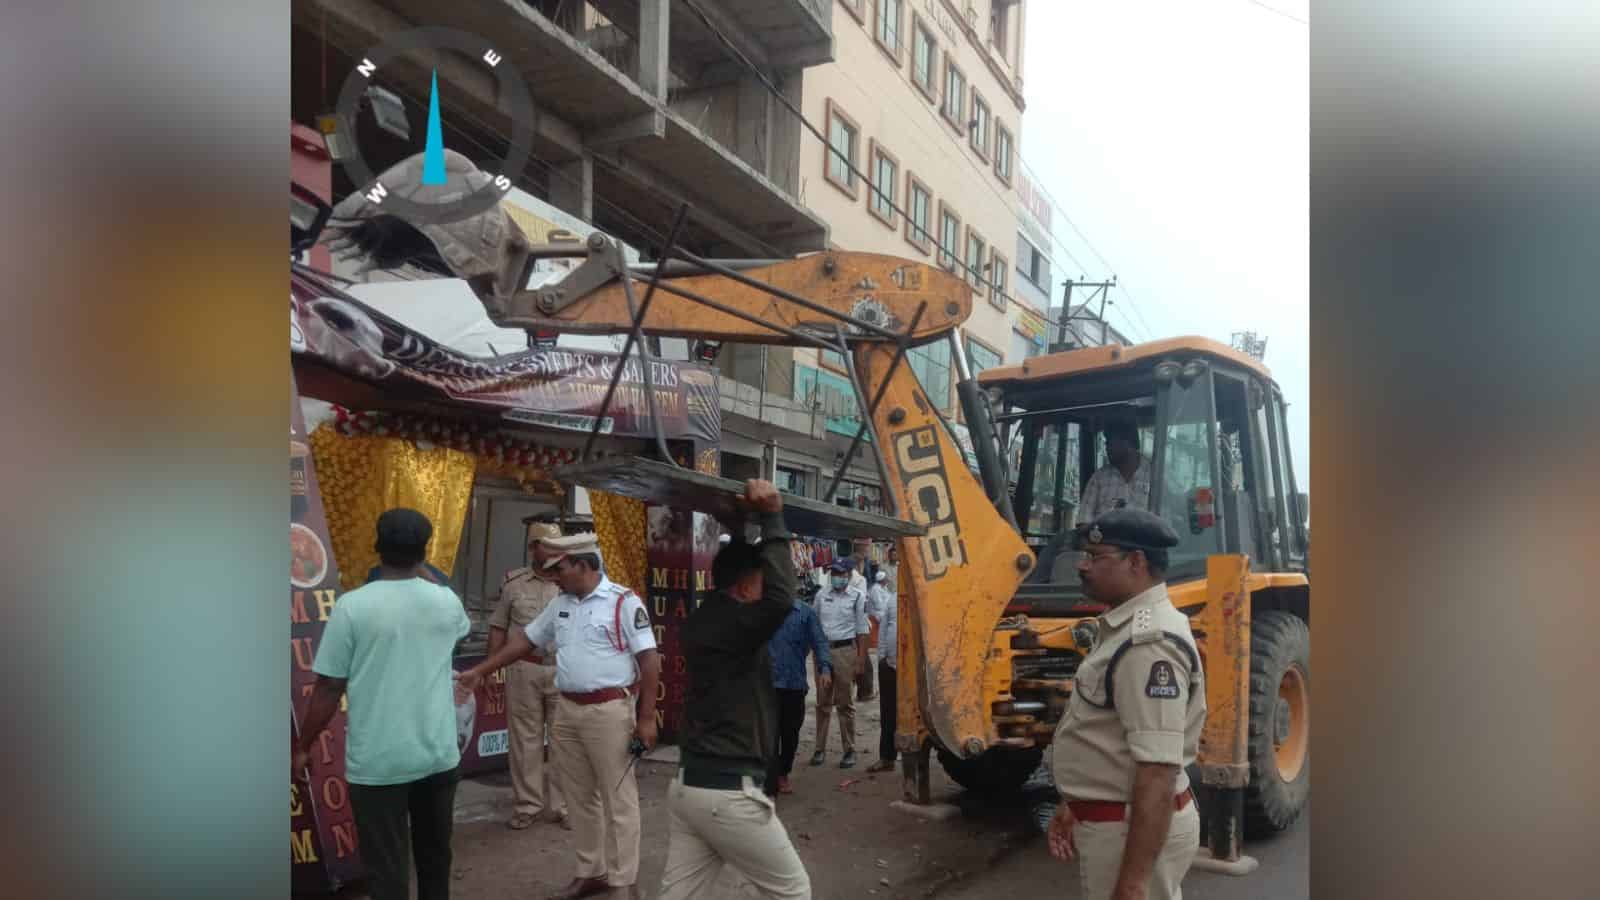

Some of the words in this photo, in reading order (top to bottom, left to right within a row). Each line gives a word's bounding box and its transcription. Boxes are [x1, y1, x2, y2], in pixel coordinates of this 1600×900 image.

[600, 355, 615, 382] &
[618, 356, 679, 387] BAERS
[896, 429, 964, 577] JCB
